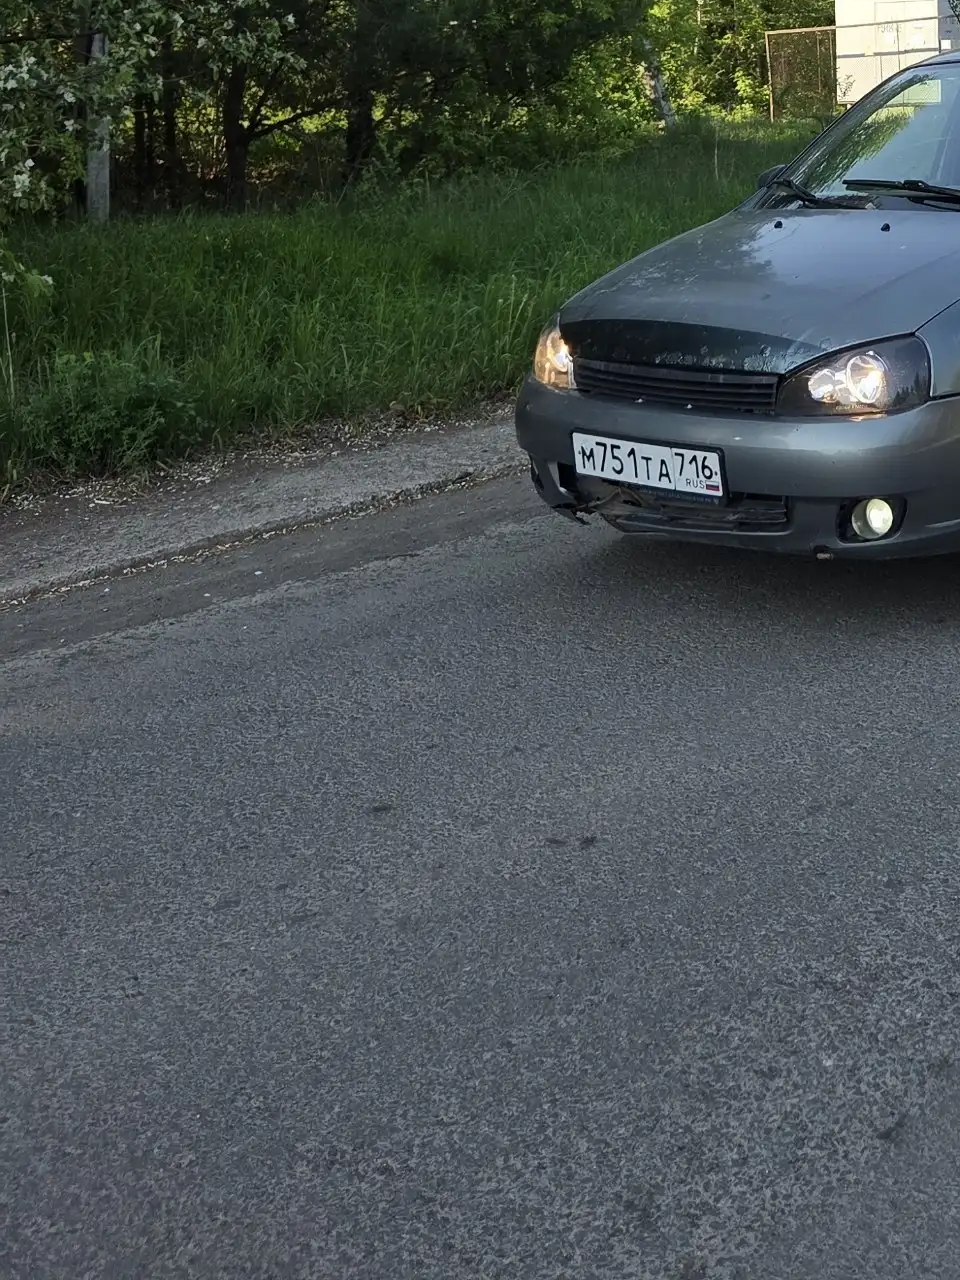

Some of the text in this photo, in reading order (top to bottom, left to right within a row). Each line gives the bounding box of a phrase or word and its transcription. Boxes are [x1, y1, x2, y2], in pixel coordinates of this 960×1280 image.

[581, 441, 714, 484] М751ТА 716
[685, 479, 705, 489] RUS
